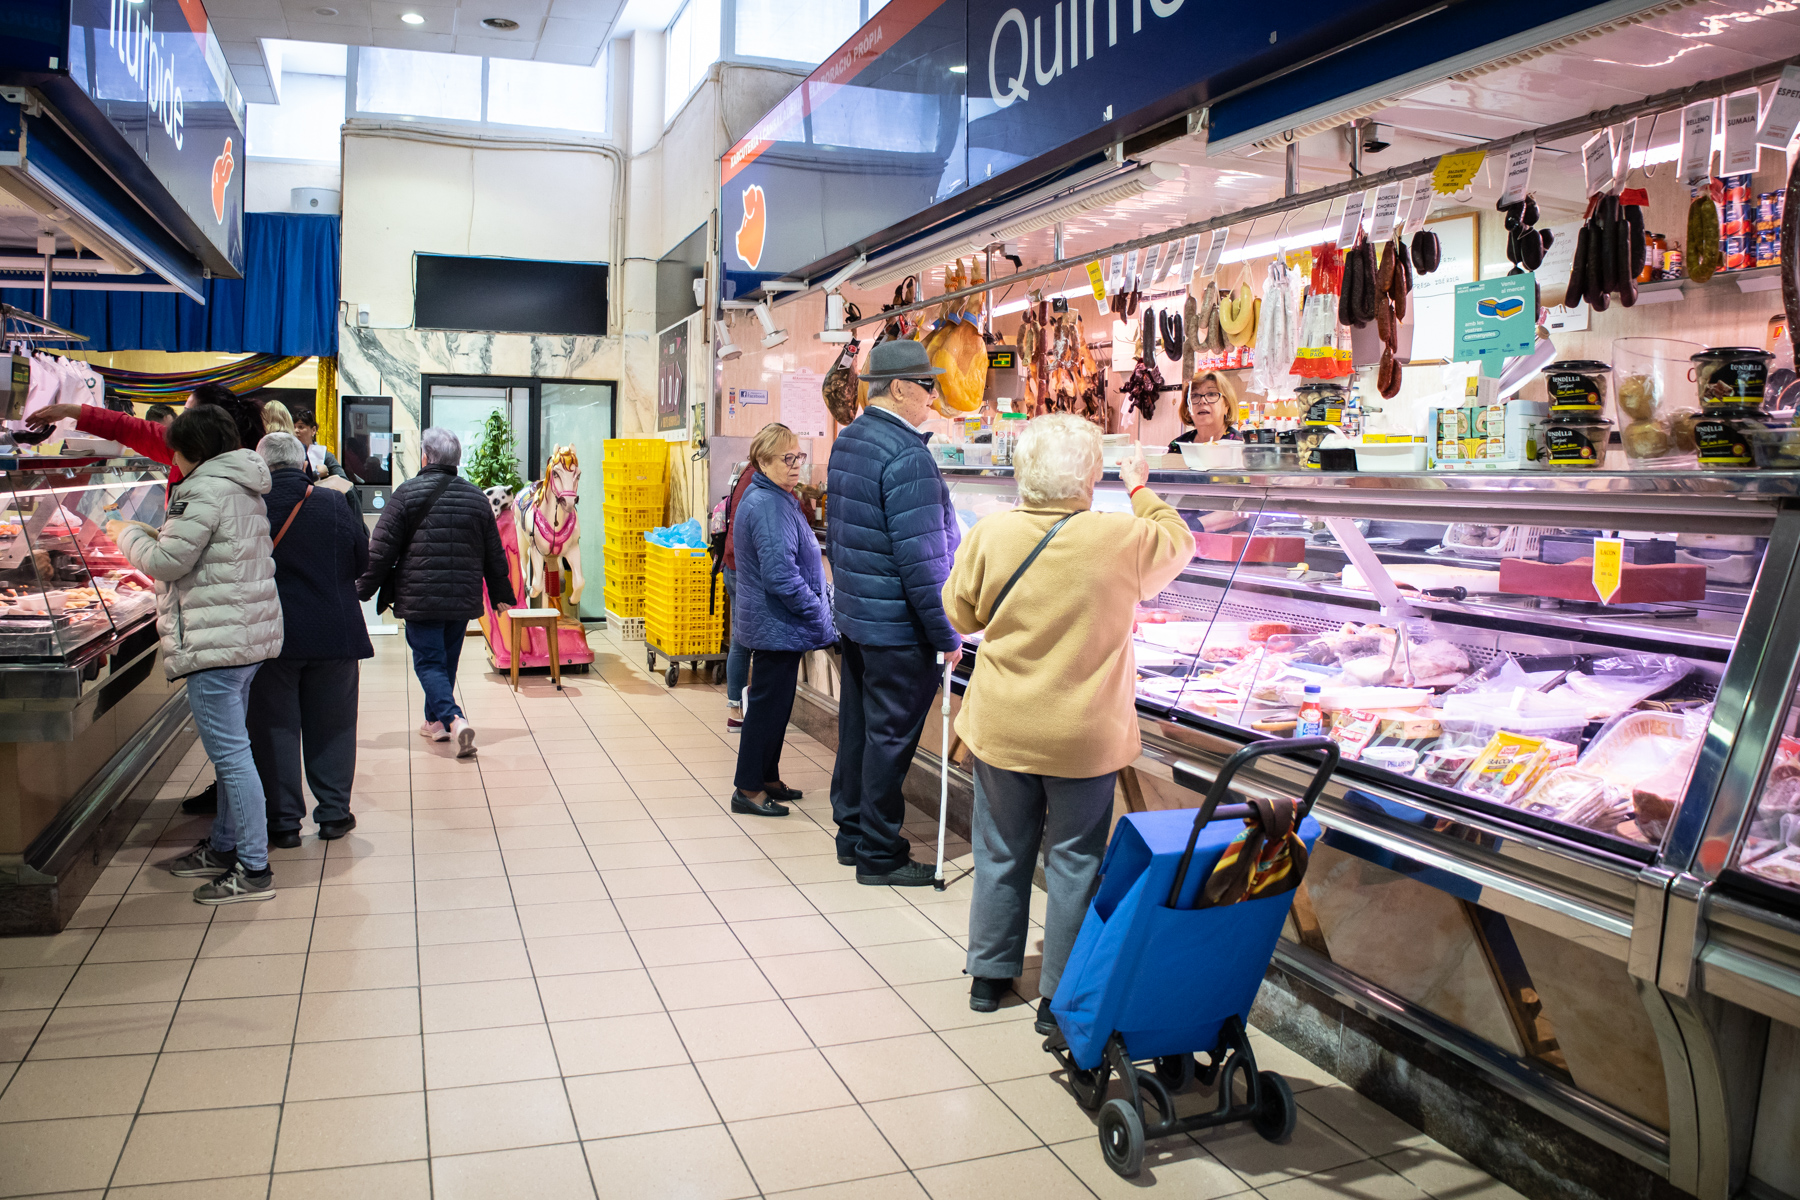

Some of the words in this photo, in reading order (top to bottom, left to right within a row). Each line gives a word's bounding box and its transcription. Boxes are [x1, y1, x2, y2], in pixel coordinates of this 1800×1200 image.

[988, 0, 1185, 108] Quim
[808, 49, 852, 99] ELABORACIÓ
[853, 25, 883, 63] PRÒPIA
[1776, 87, 1800, 99] ESPET
[1686, 115, 1710, 126] RELLENO
[1727, 115, 1756, 127] SUMAIA
[1509, 148, 1533, 159] MORCILLA
[1586, 140, 1610, 160] MORCILLA
[1512, 158, 1528, 167] ARROZ
[1508, 167, 1529, 177] PIÑONES
[1346, 202, 1363, 210] MORCILLA
[1507, 285, 1526, 293] mercat
[1464, 331, 1496, 340] carmanyoles
